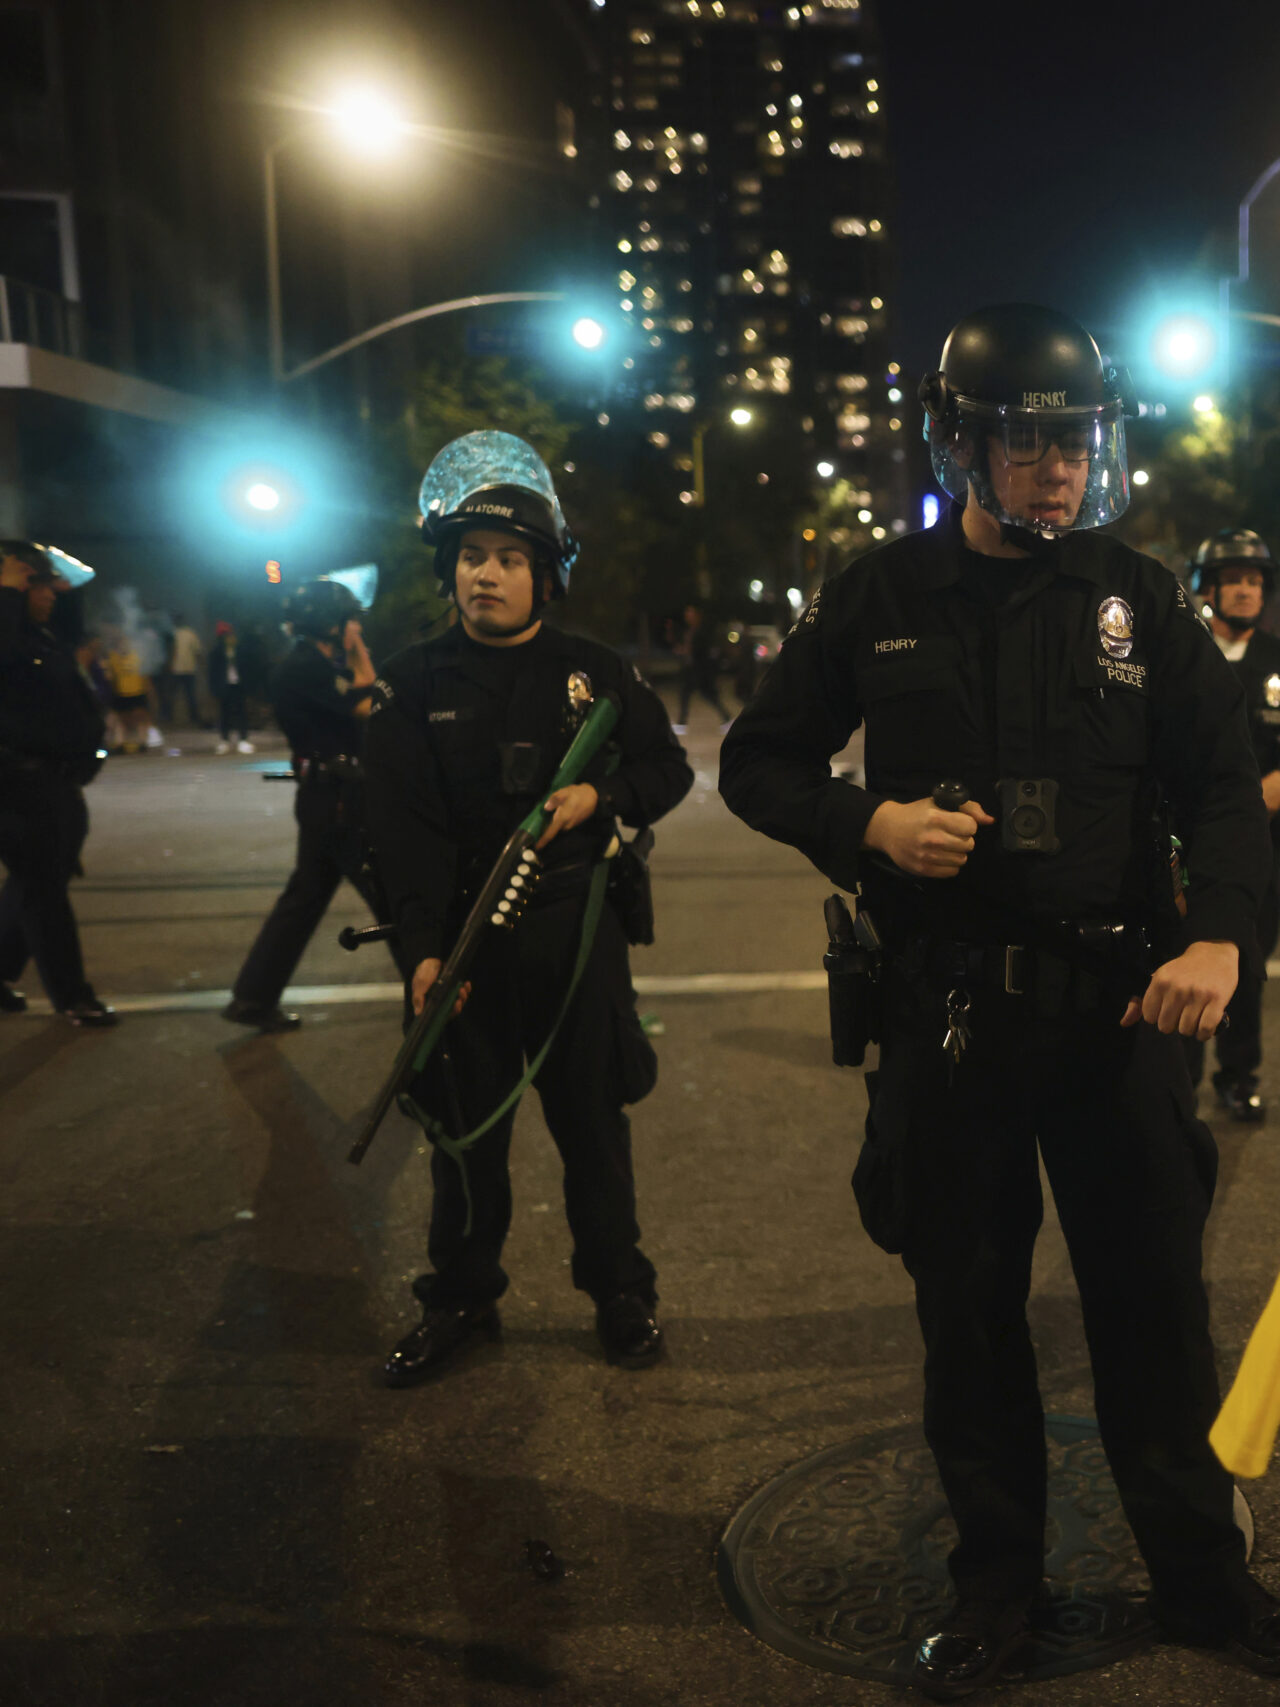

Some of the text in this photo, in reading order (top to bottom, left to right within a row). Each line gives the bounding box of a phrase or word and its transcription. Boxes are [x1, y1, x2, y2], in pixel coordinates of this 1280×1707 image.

[1023, 390, 1067, 408] HENRY
[874, 637, 919, 655] HENRY
[1097, 655, 1147, 677] LOS ANGELES
[1107, 667, 1144, 688] POLICE
